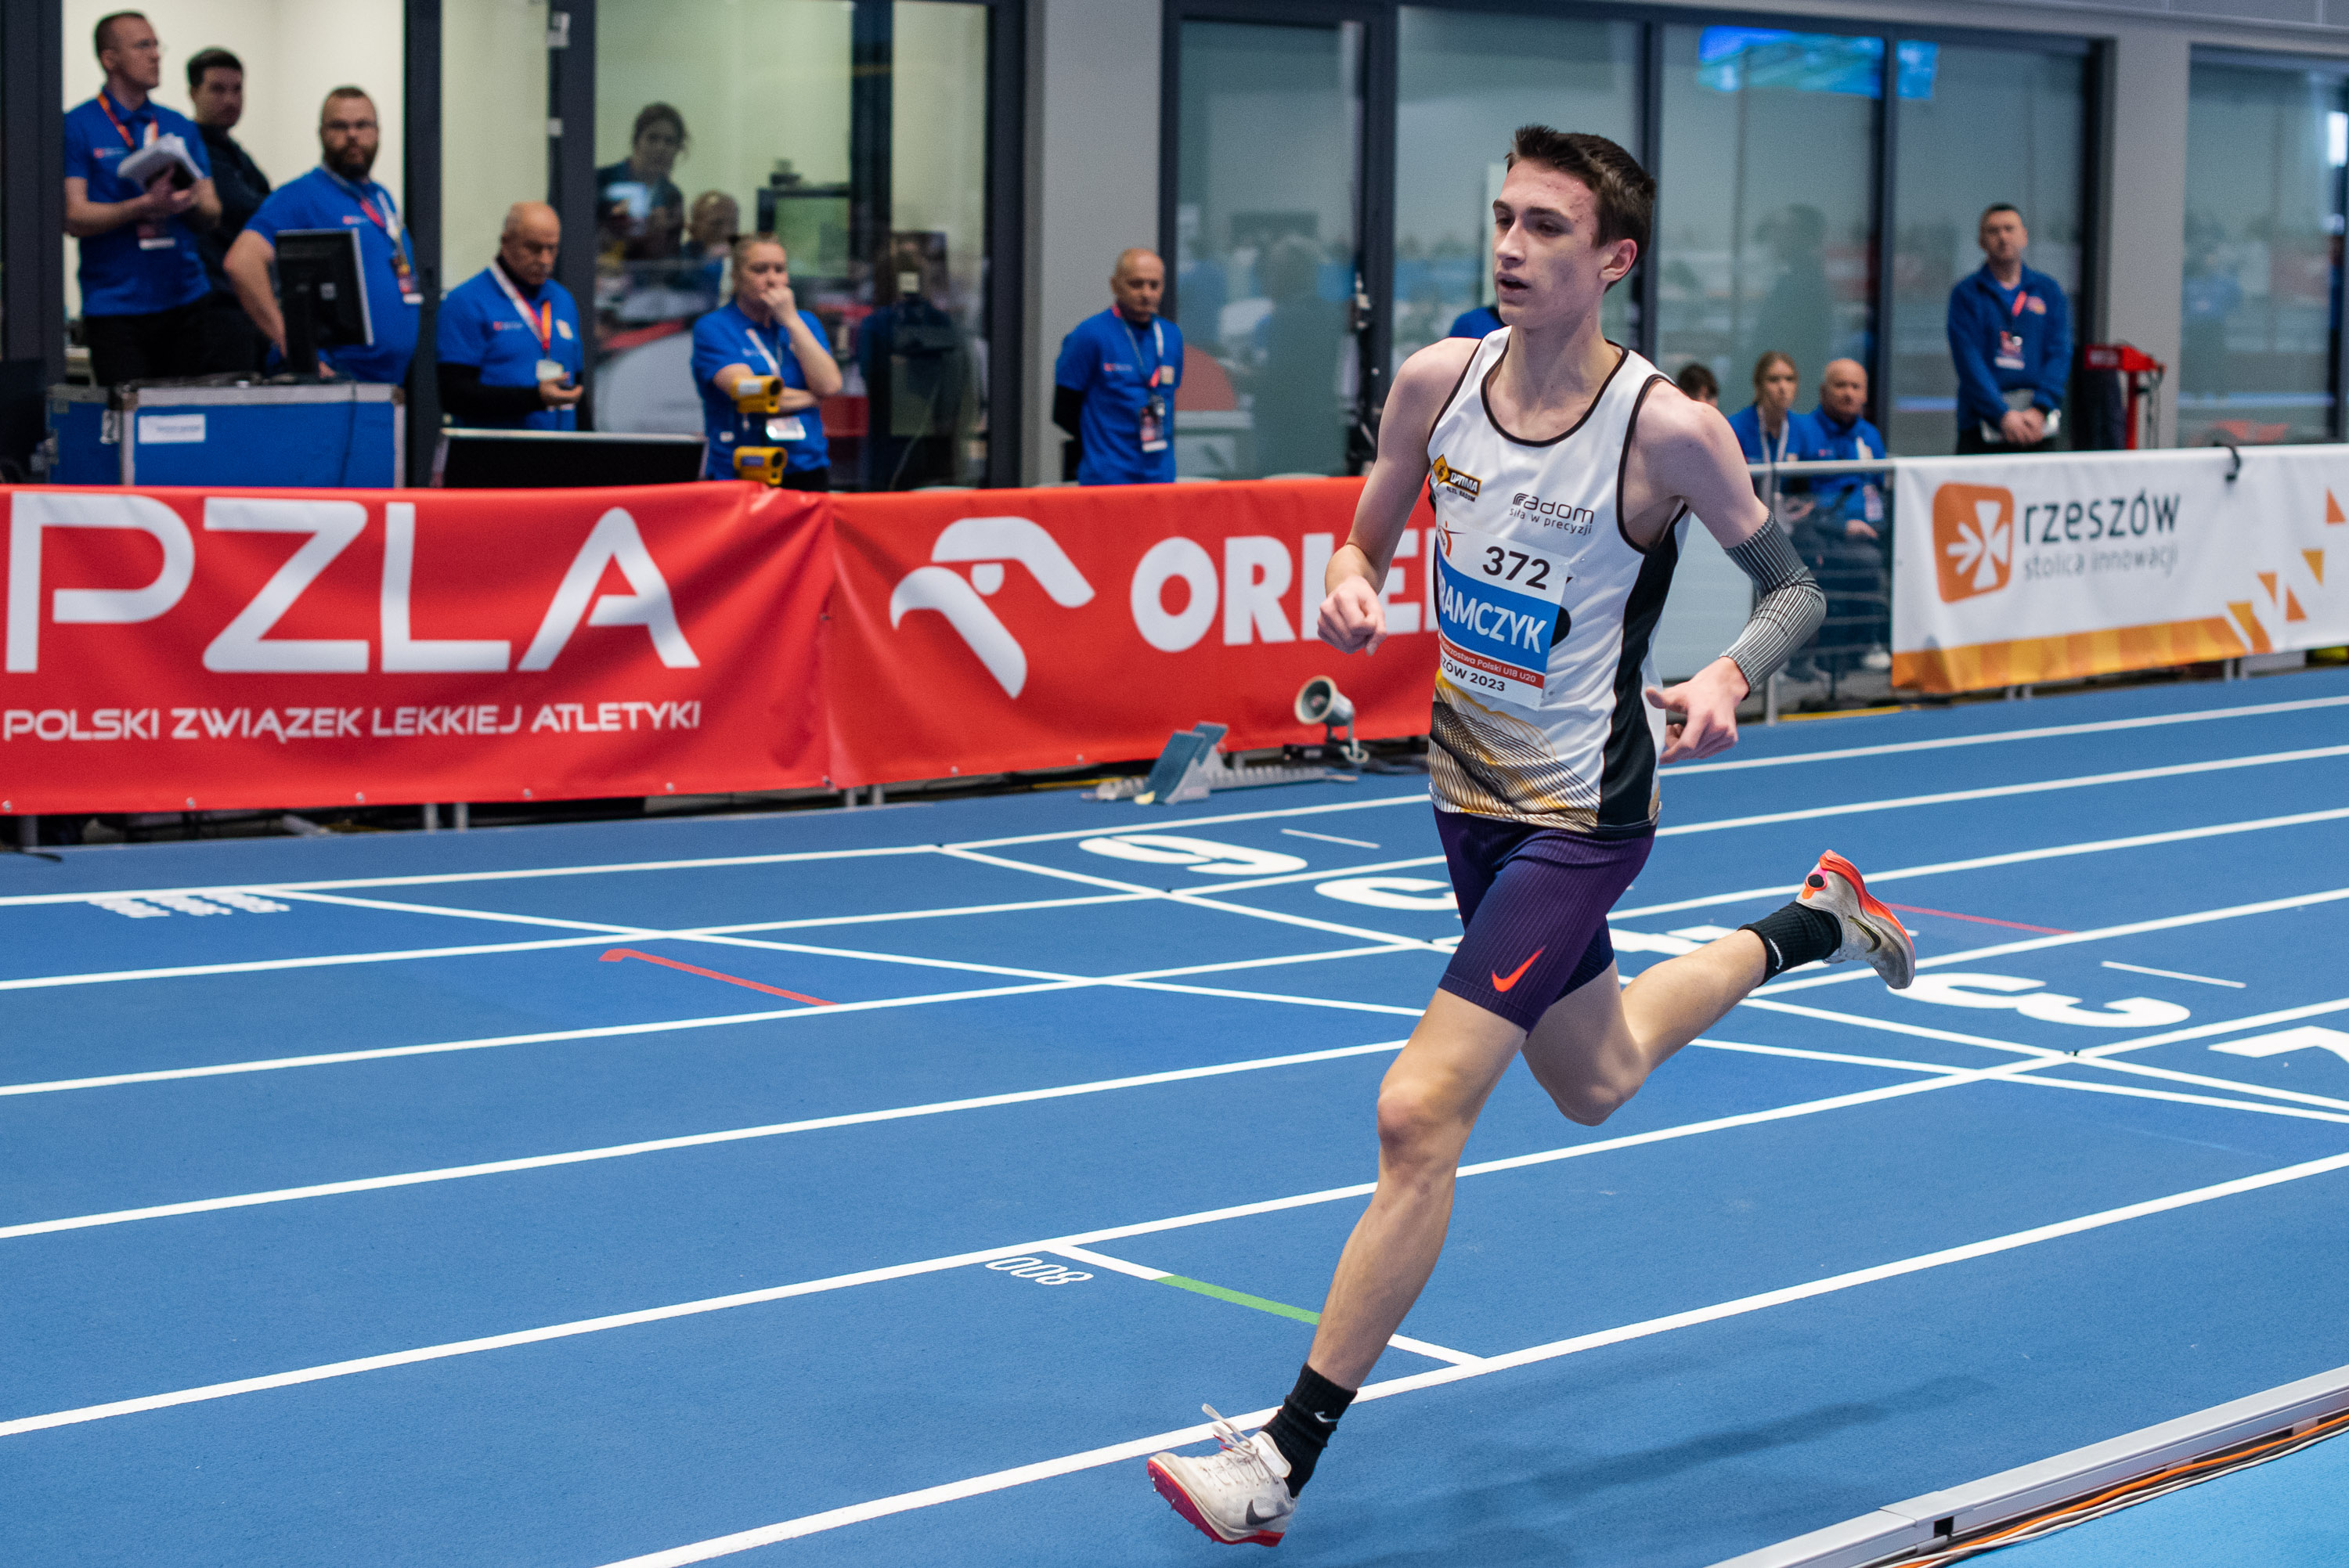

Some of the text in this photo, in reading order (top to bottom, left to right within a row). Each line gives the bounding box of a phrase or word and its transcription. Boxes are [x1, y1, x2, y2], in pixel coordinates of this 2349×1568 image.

[1510, 508, 1592, 536] siła w precyzji
[2024, 487, 2180, 545] rzeszów
[5, 492, 701, 673] PZLA
[1482, 546, 1550, 590] 372
[2024, 550, 2084, 582] stolica
[1130, 528, 1436, 653] ORLE
[1438, 562, 1547, 654] RAMCZYK
[1442, 656, 1505, 692] ZÓW 2023
[1477, 658, 1502, 672] Polski
[1503, 667, 1517, 677] U18
[1520, 671, 1536, 683] U20
[3, 701, 702, 744] POLSKI ZWIĄZEK LEKKIEJ ATLETYKI
[985, 1257, 1095, 1285] 800
